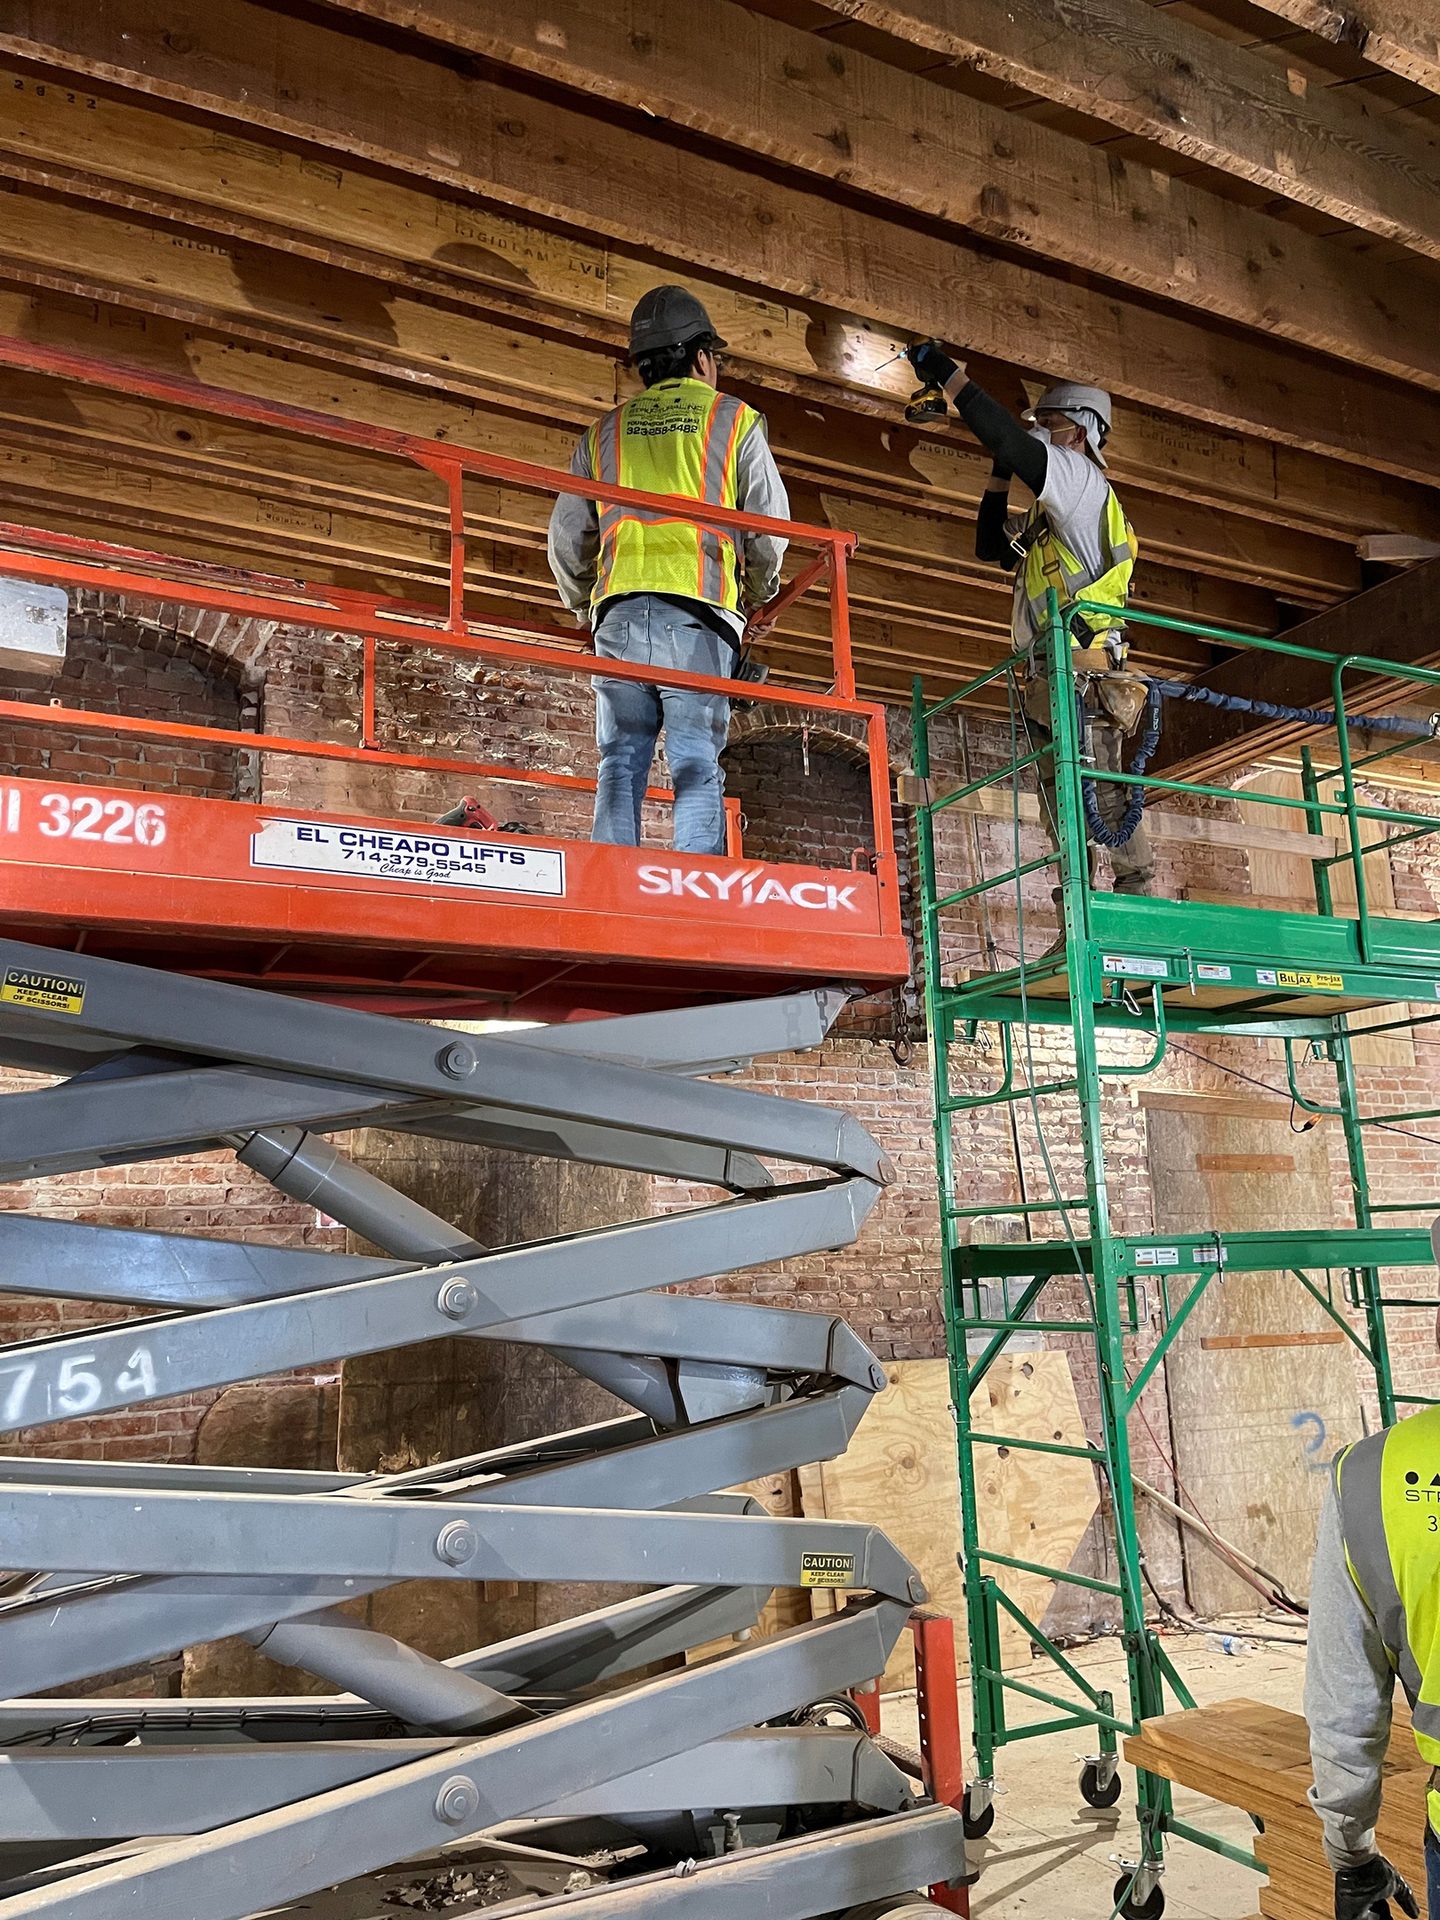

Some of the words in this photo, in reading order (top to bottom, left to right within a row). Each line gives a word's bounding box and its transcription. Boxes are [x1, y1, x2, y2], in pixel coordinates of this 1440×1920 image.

[38, 793, 167, 847] 3226
[297, 826, 329, 843] EL
[339, 832, 450, 857] CHEAPO
[459, 845, 526, 866] LIFTS
[342, 848, 487, 874] 714-379-5545
[379, 862, 412, 877] Cheap
[414, 867, 423, 876] is
[425, 868, 452, 880] Good
[636, 864, 863, 914] SKYJACK
[7, 971, 83, 995] CAUTION!
[16, 988, 39, 997] KEEP
[41, 992, 69, 1002] CLEAR
[26, 996, 70, 1009] SCISSORS!
[1405, 1489, 1440, 1503] ST
[804, 1557, 853, 1569] CAUTION!
